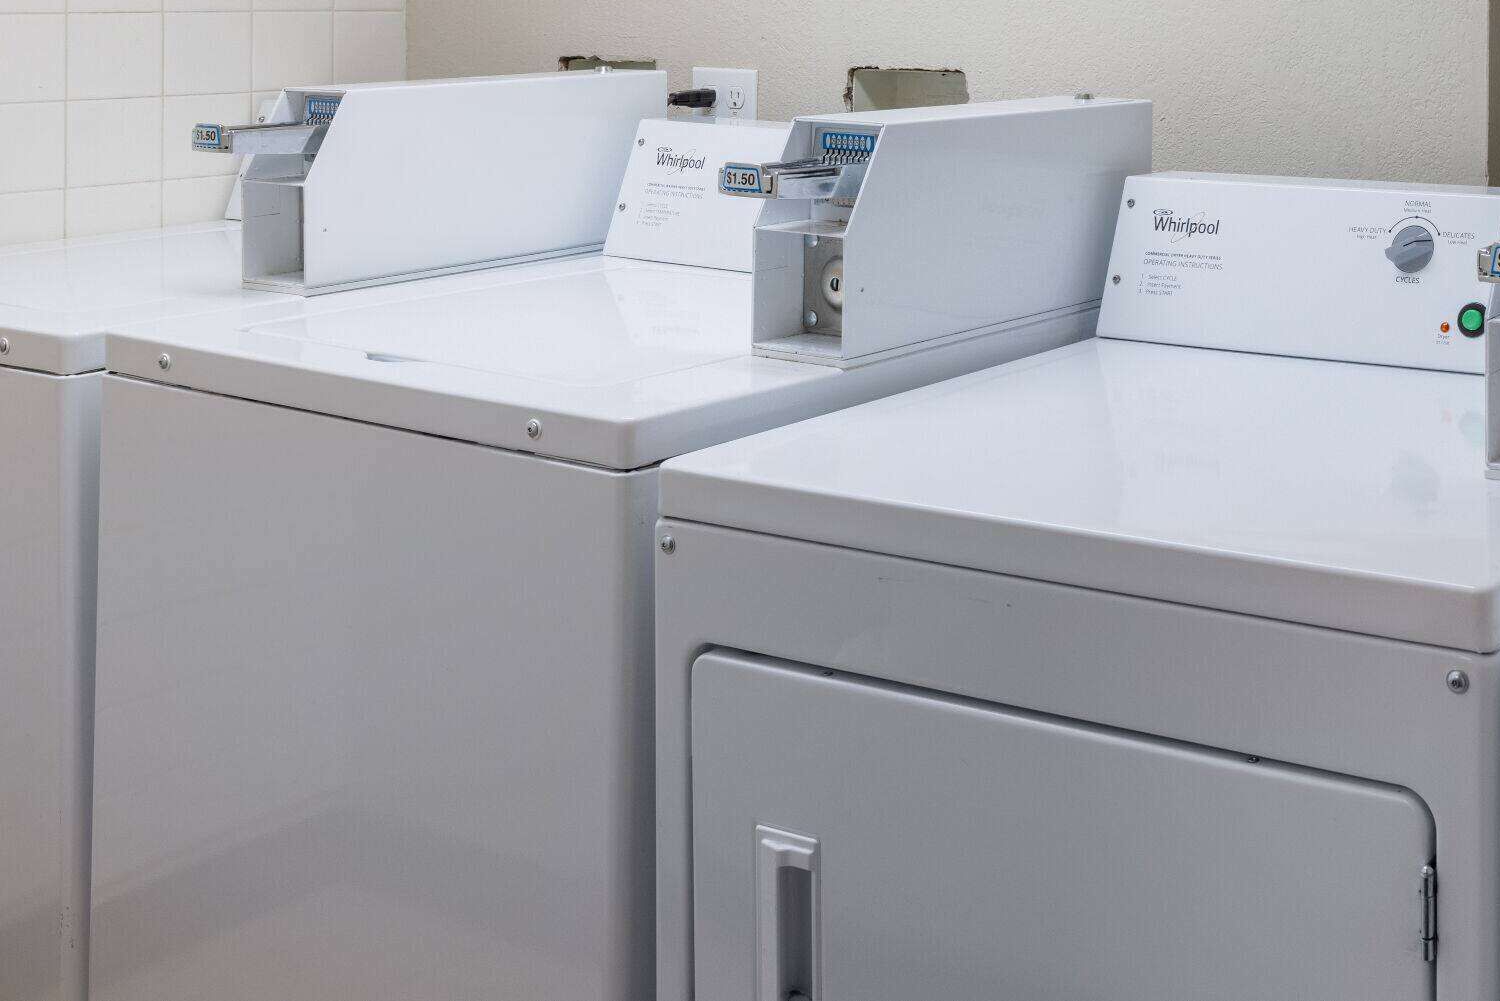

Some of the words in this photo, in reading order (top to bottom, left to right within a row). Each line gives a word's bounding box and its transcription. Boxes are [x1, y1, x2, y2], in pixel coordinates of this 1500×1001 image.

[656, 152, 705, 173] Whirlpool
[726, 171, 755, 186] $1.50
[1154, 216, 1220, 237] Whirlpool
[1144, 259, 1176, 267] OPERATING
[1179, 261, 1222, 270] INSTRUCTIONS
[1395, 276, 1420, 284] CYCLES
